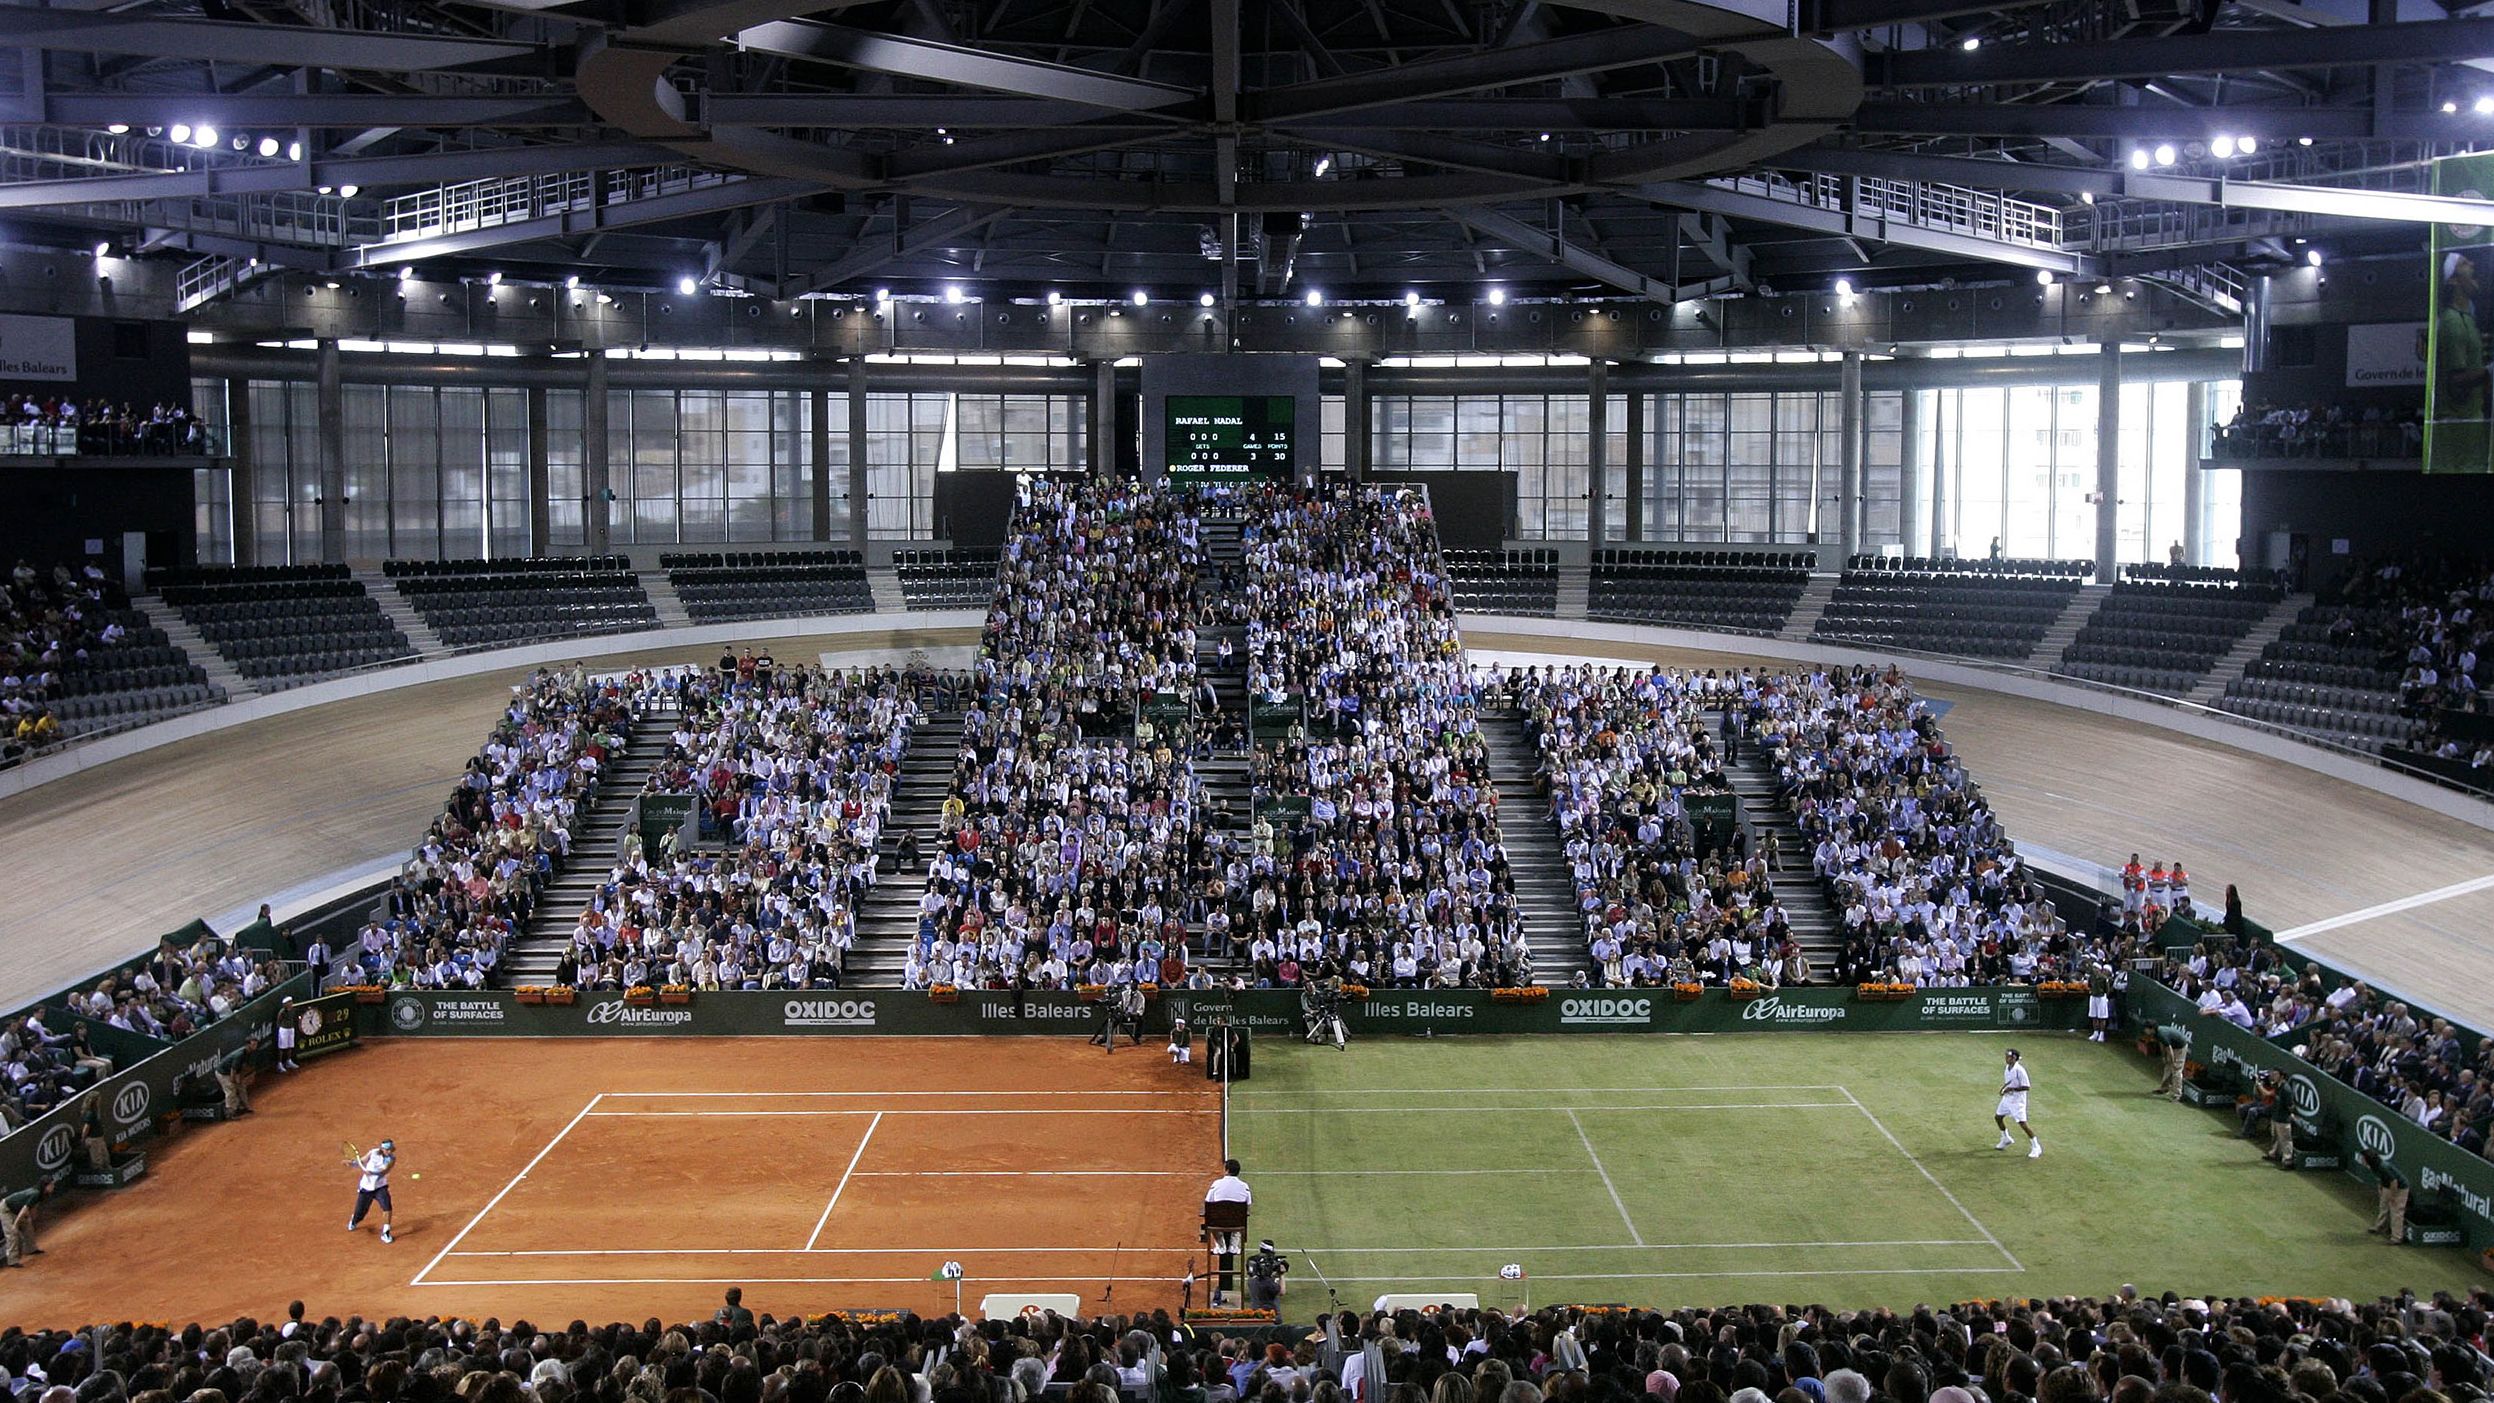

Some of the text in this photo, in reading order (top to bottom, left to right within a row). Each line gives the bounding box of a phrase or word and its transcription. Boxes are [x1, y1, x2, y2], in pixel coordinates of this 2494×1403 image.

[0, 359, 67, 375] lles Balears
[2355, 368, 2397, 380] Govern
[2399, 366, 2413, 380] de
[1175, 417, 1243, 425] RAFAEL NADAL
[1190, 433, 1196, 441] 0
[1201, 433, 1207, 441] 0
[1212, 433, 1218, 441] 0
[1249, 433, 1255, 441] 4
[1190, 452, 1285, 460] 0 0 0 3 30
[436, 1001, 500, 1010] THE BATTLE
[1193, 1002, 1233, 1012] Govern
[1561, 999, 1651, 1016] OXIDOC
[1925, 997, 1988, 1005] THE BATTLE
[336, 1008, 349, 1021] 29
[433, 1010, 504, 1019] OF SURFACES
[620, 1008, 692, 1024] AirEuropa
[784, 1000, 875, 1018] OXIDOC
[982, 1002, 1092, 1018] Illes Balears
[1364, 1002, 1473, 1017] Illes Balears
[1775, 1005, 1845, 1020] AirEuropa
[1921, 1006, 1991, 1014] OF SURFACES
[1193, 1015, 1207, 1025] de
[1249, 1015, 1289, 1025] Balears
[308, 1031, 341, 1046] ROLEX
[120, 1088, 145, 1117] KIA
[2363, 1121, 2389, 1154] KIA
